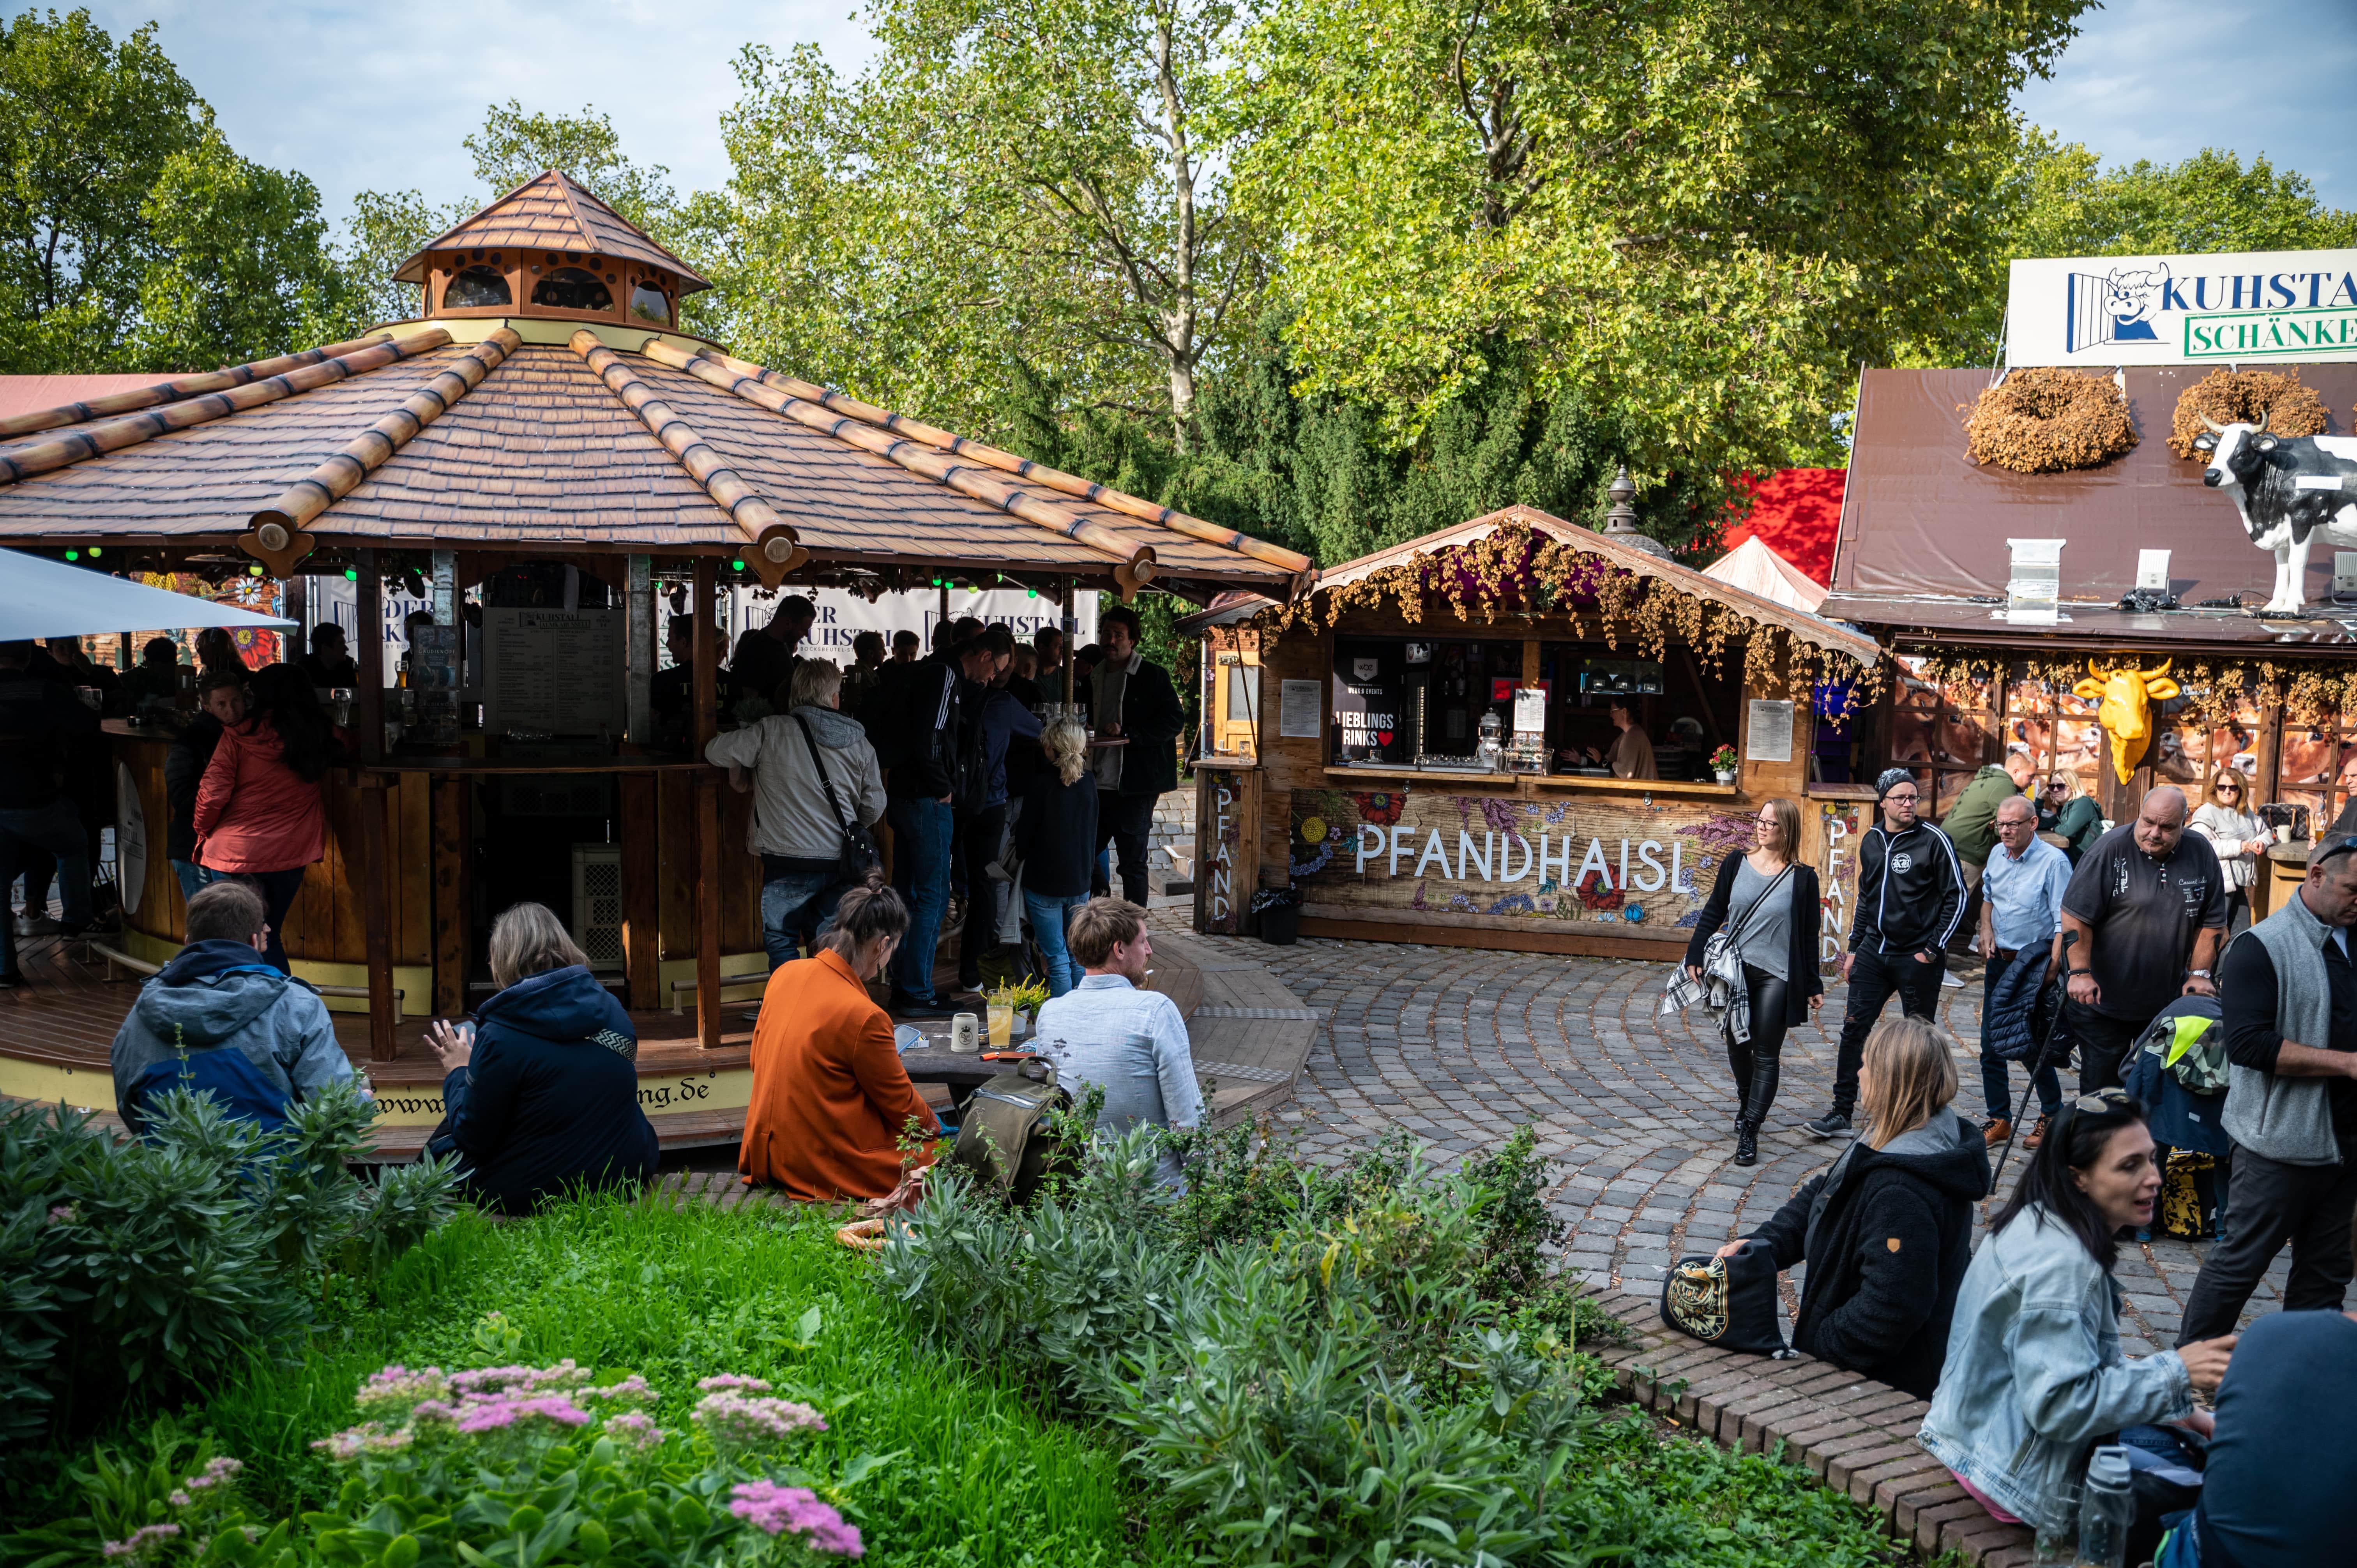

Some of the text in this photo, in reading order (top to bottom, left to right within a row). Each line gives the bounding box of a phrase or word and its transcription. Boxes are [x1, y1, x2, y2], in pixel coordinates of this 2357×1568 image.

[1214, 788, 1232, 920] PFAND
[1356, 824, 1698, 894] PFANDHAISL
[1822, 819, 1847, 962] PFAND
